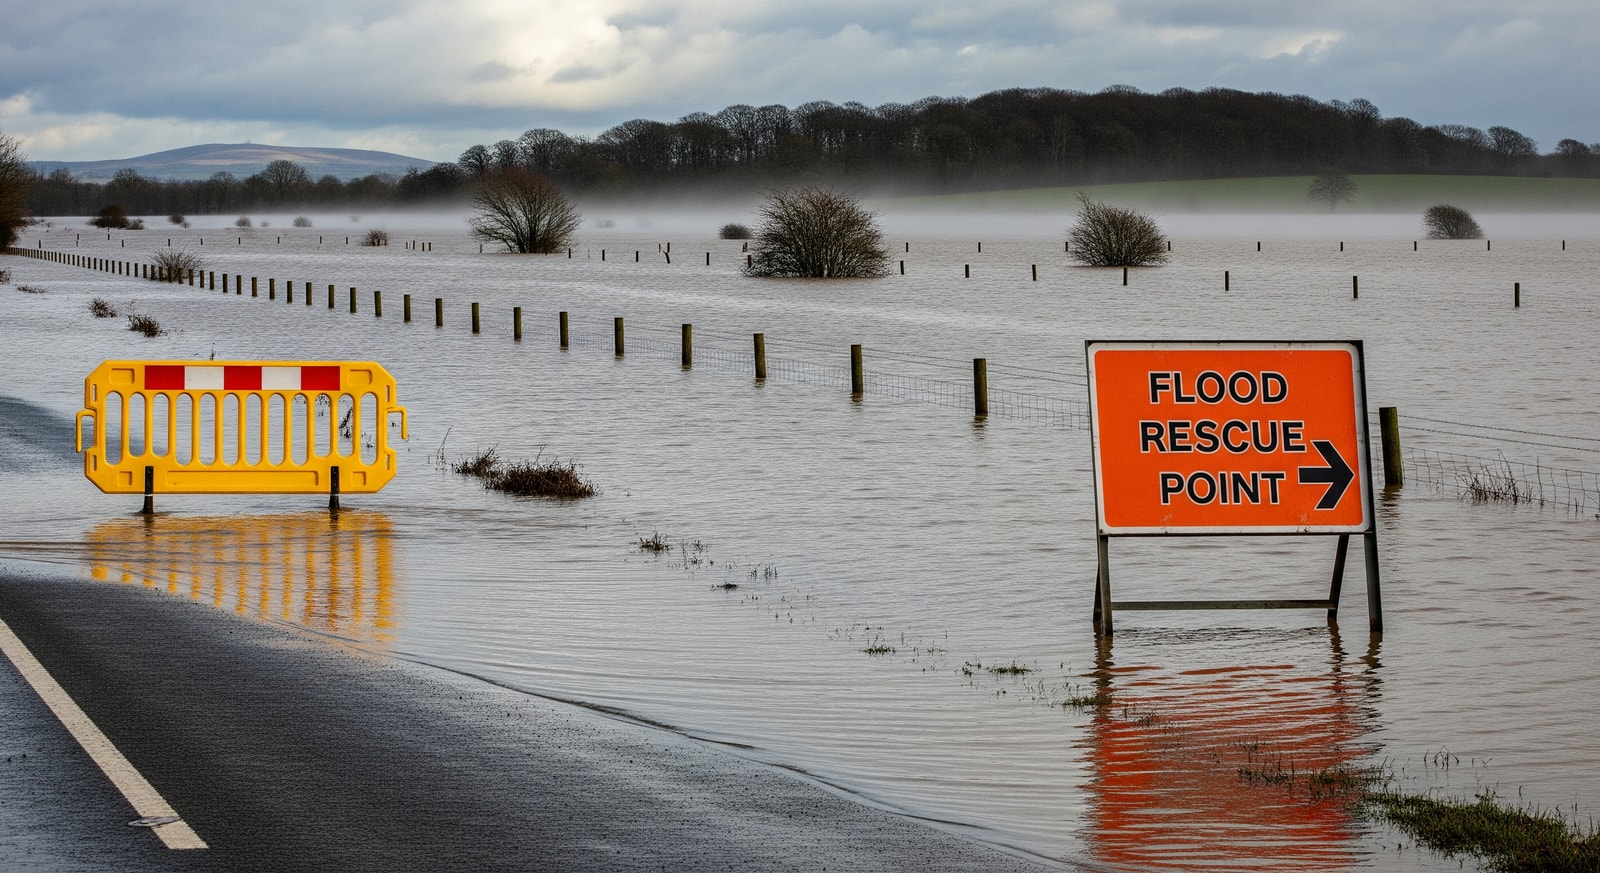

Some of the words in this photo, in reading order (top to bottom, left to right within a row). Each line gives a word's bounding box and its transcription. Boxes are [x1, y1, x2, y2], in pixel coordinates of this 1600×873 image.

[1148, 371, 1288, 405] FLOOD
[1139, 419, 1307, 454] RESCUE
[1160, 471, 1286, 505] POINT
